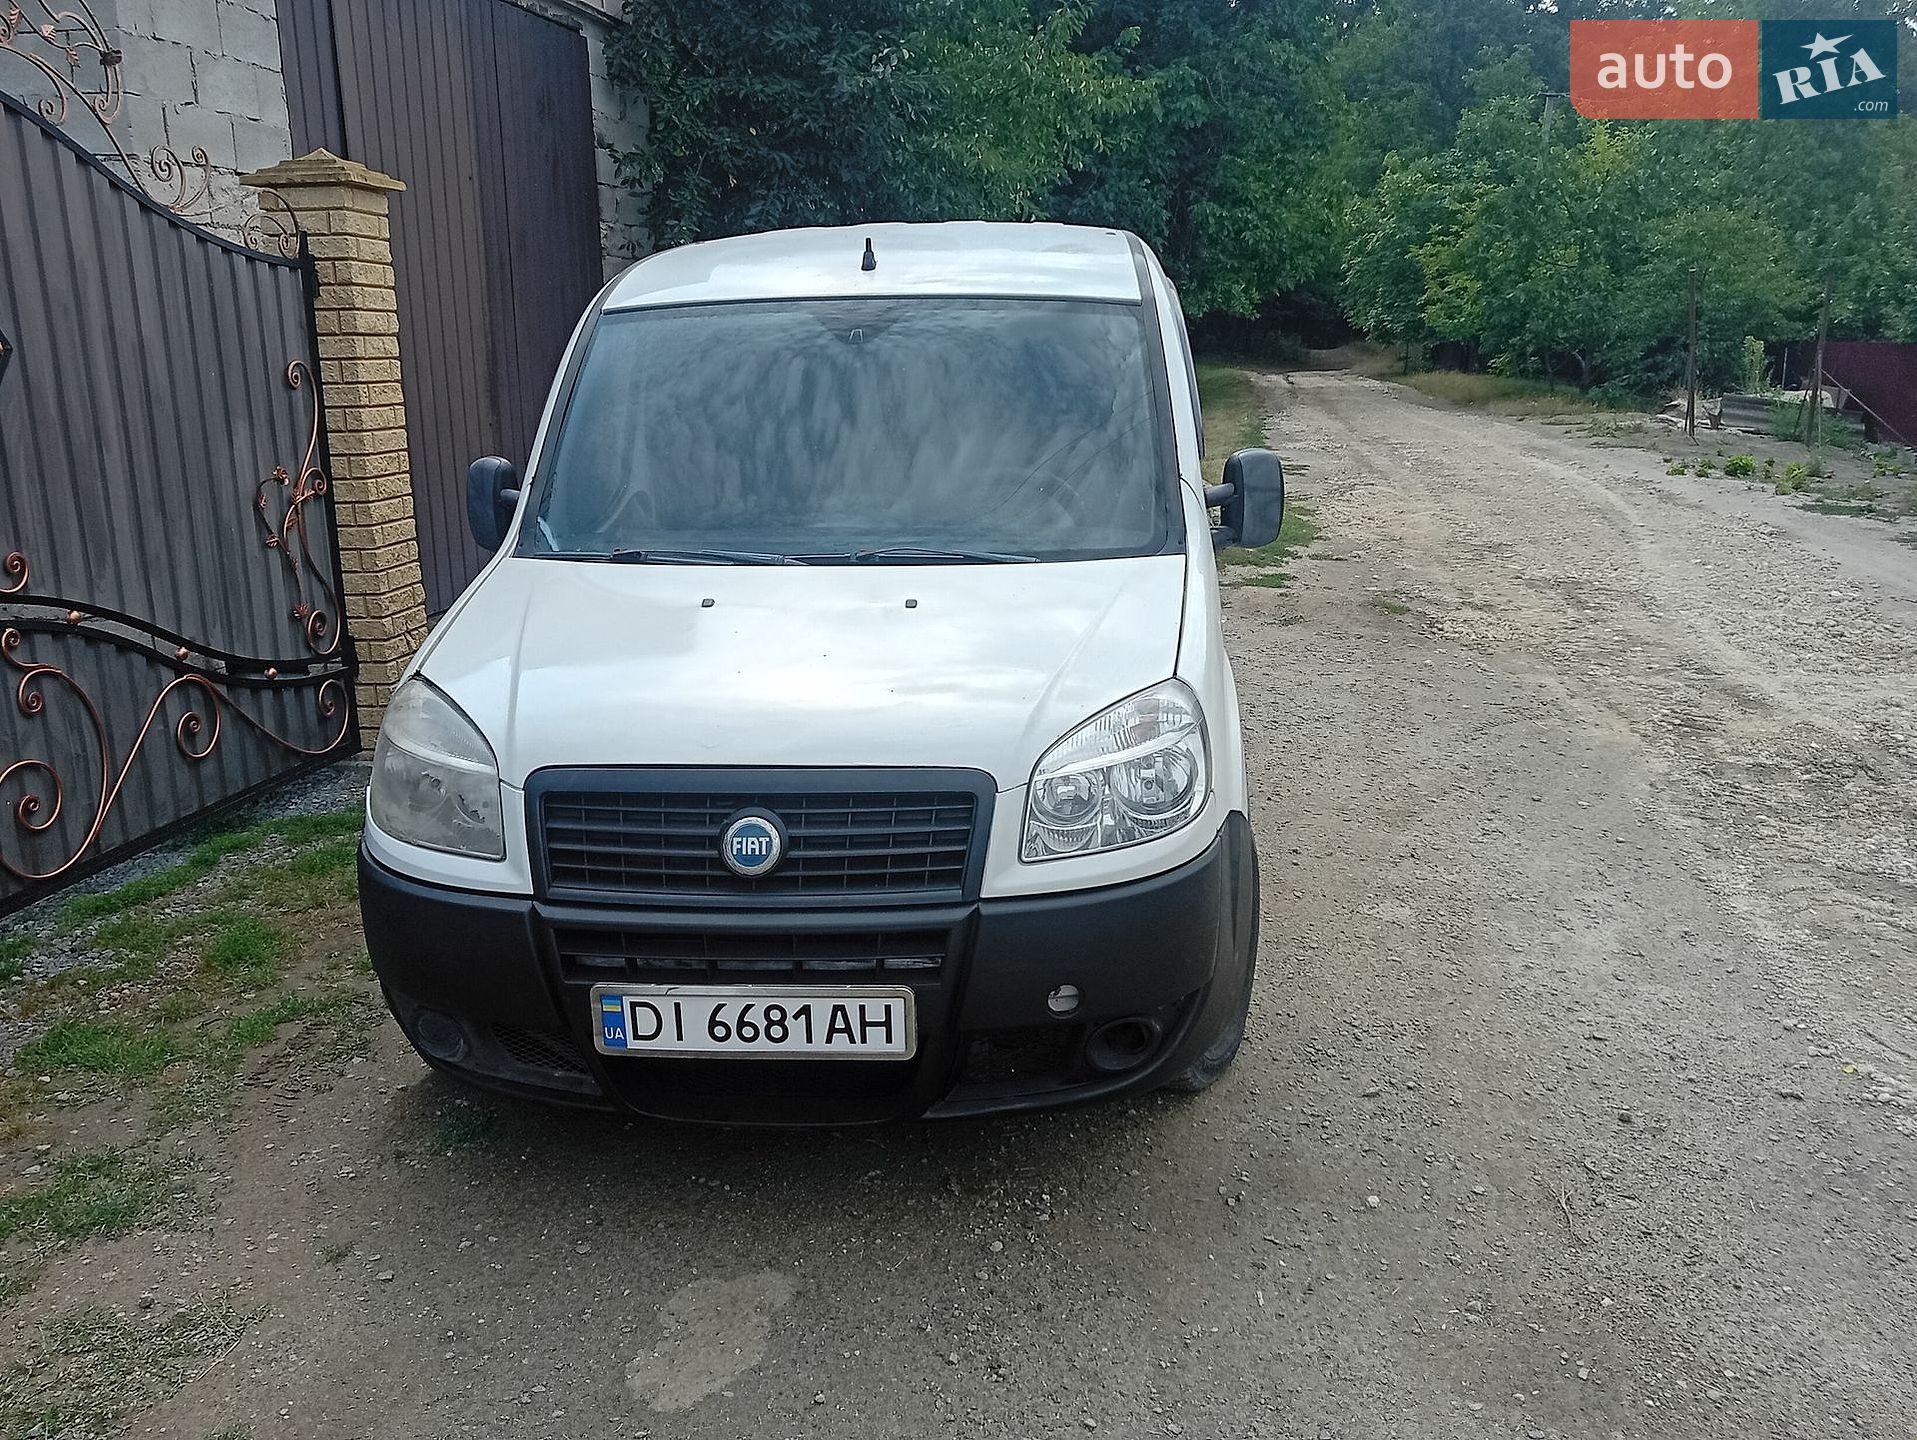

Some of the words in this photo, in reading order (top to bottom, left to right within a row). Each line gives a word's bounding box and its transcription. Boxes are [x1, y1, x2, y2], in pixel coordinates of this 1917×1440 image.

[732, 837, 770, 855] FIAT
[629, 1001, 685, 1042] DI
[604, 1027, 625, 1040] UA
